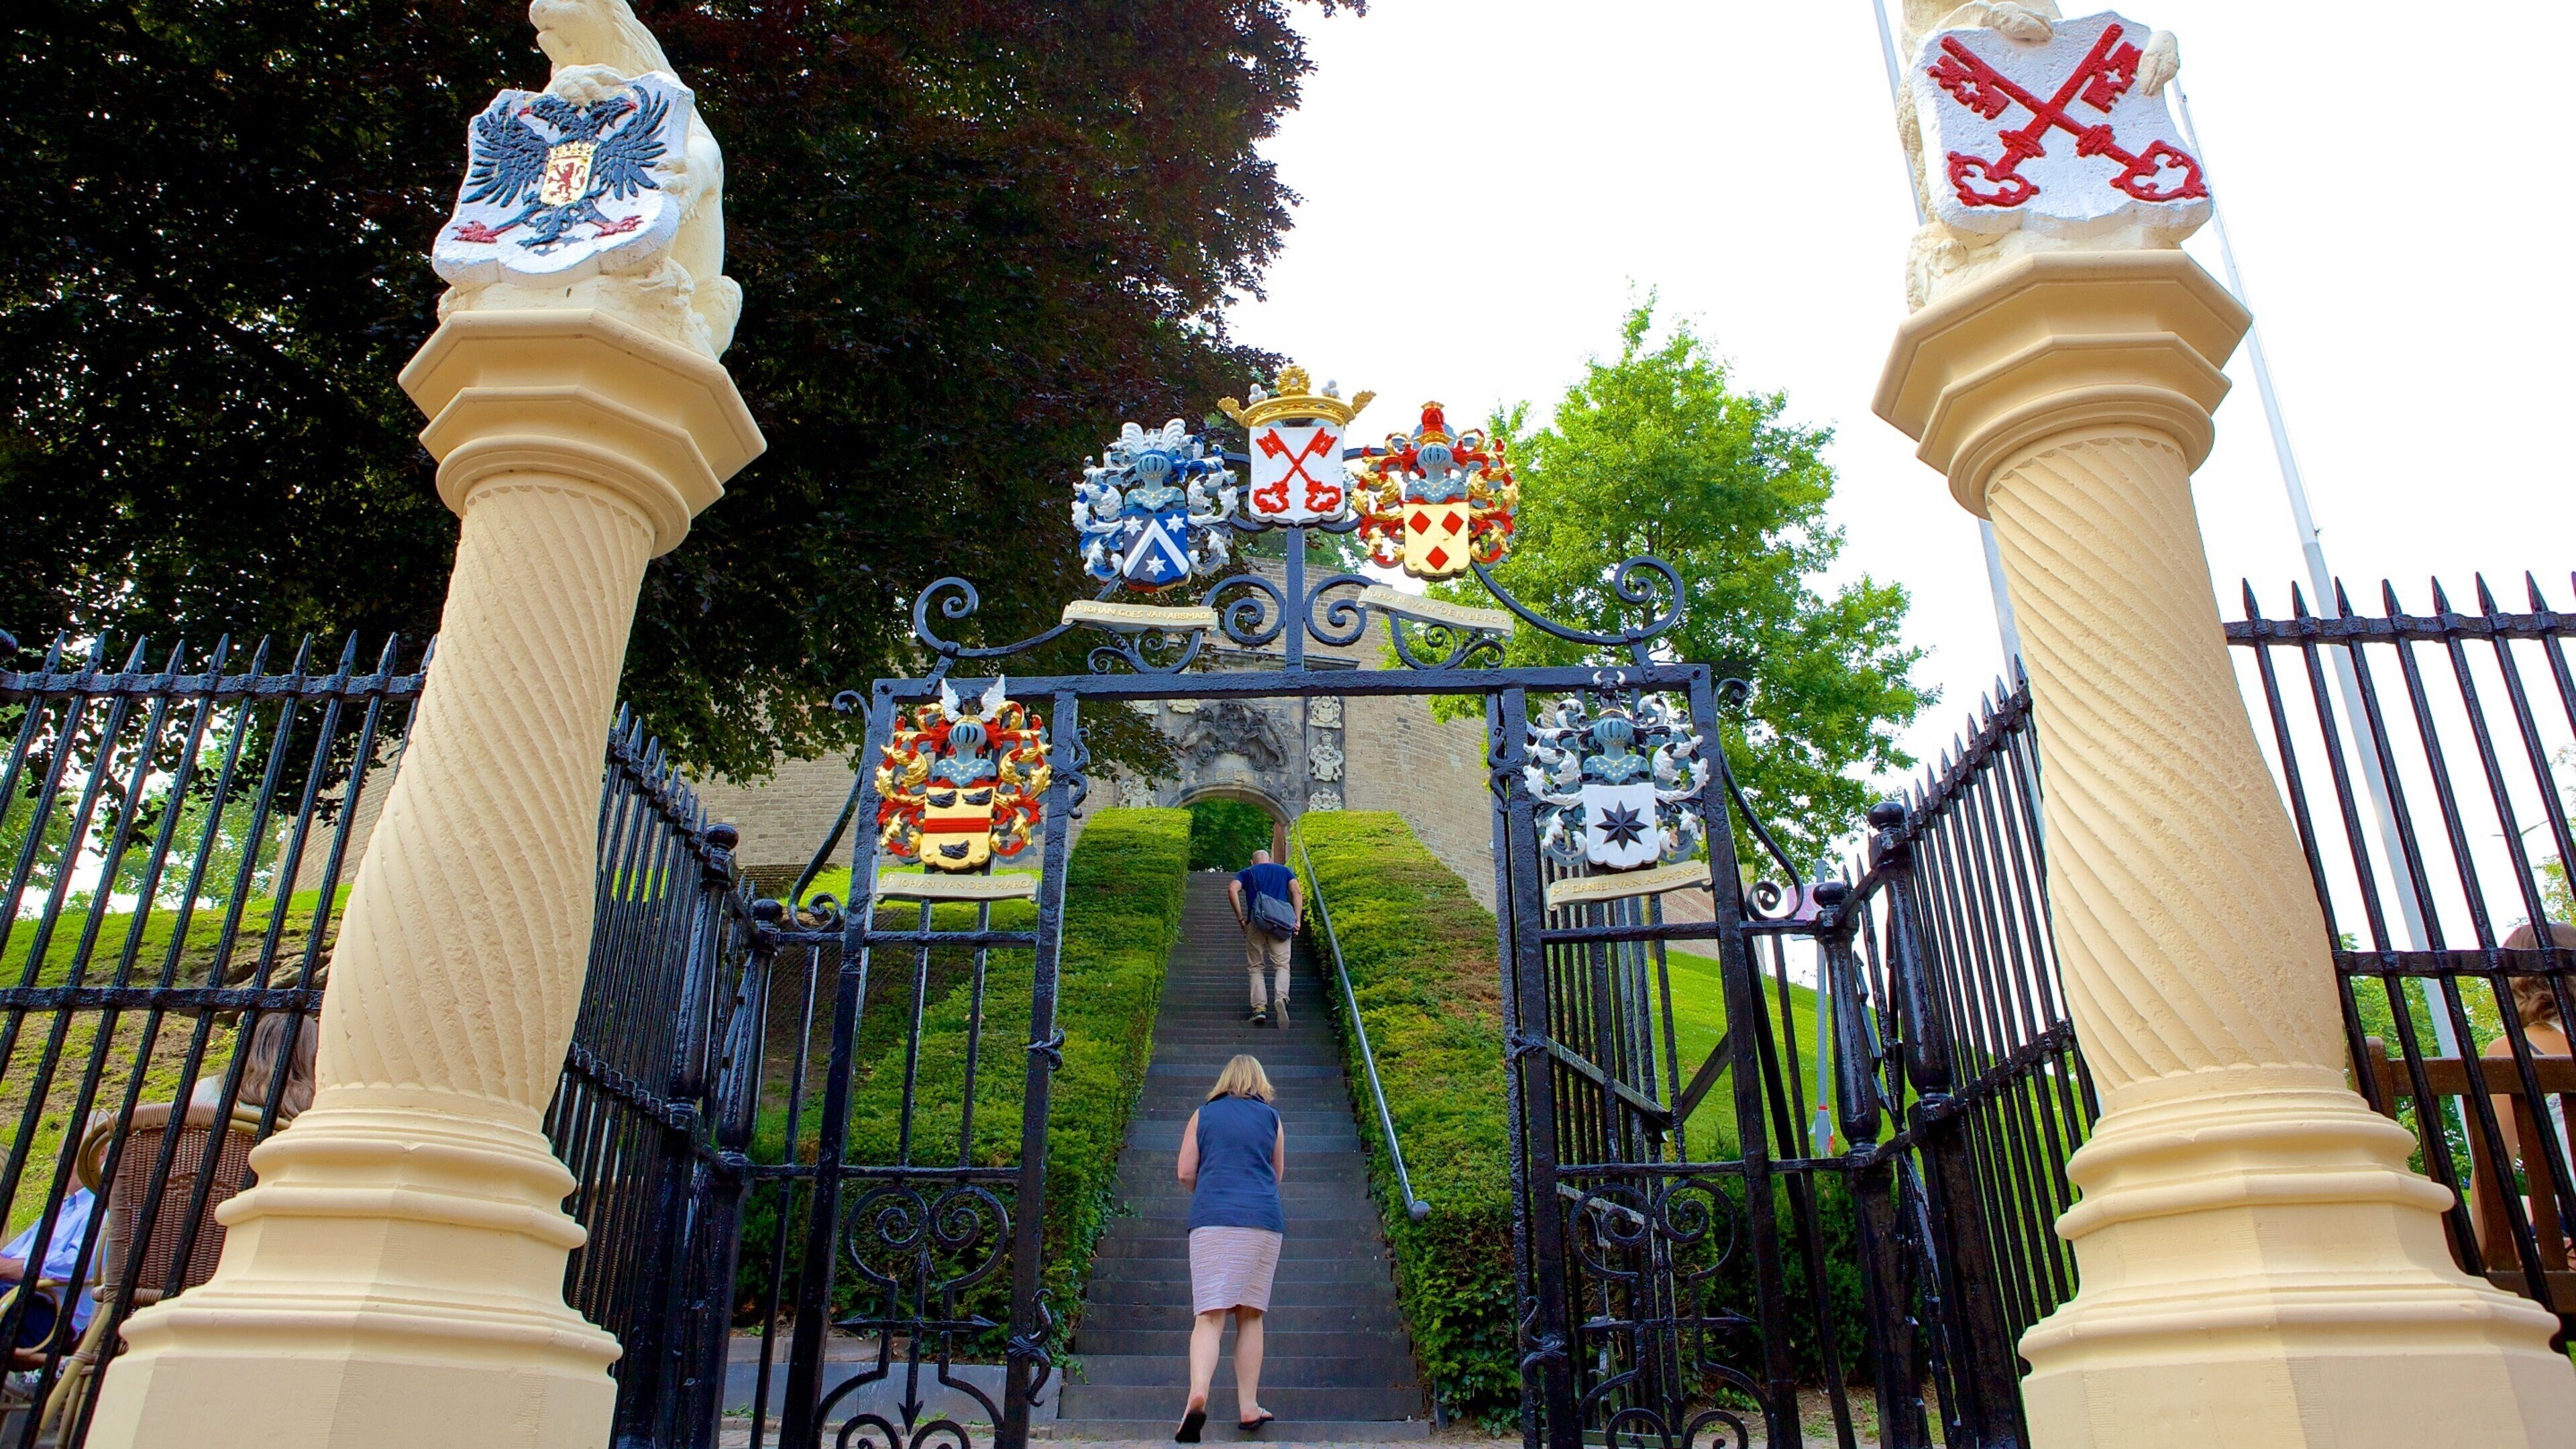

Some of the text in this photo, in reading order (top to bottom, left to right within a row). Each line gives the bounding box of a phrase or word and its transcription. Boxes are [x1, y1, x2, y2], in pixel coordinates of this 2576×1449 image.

[1118, 609, 1143, 618] GOES
[1411, 599, 1436, 612] VAN
[1440, 607, 1465, 619] DEN
[941, 881, 965, 889] VAN
[968, 881, 990, 890] DER
[995, 879, 1034, 890] MARCK
[1572, 881, 1613, 893] DANIEL
[1615, 879, 1641, 890] VAN
